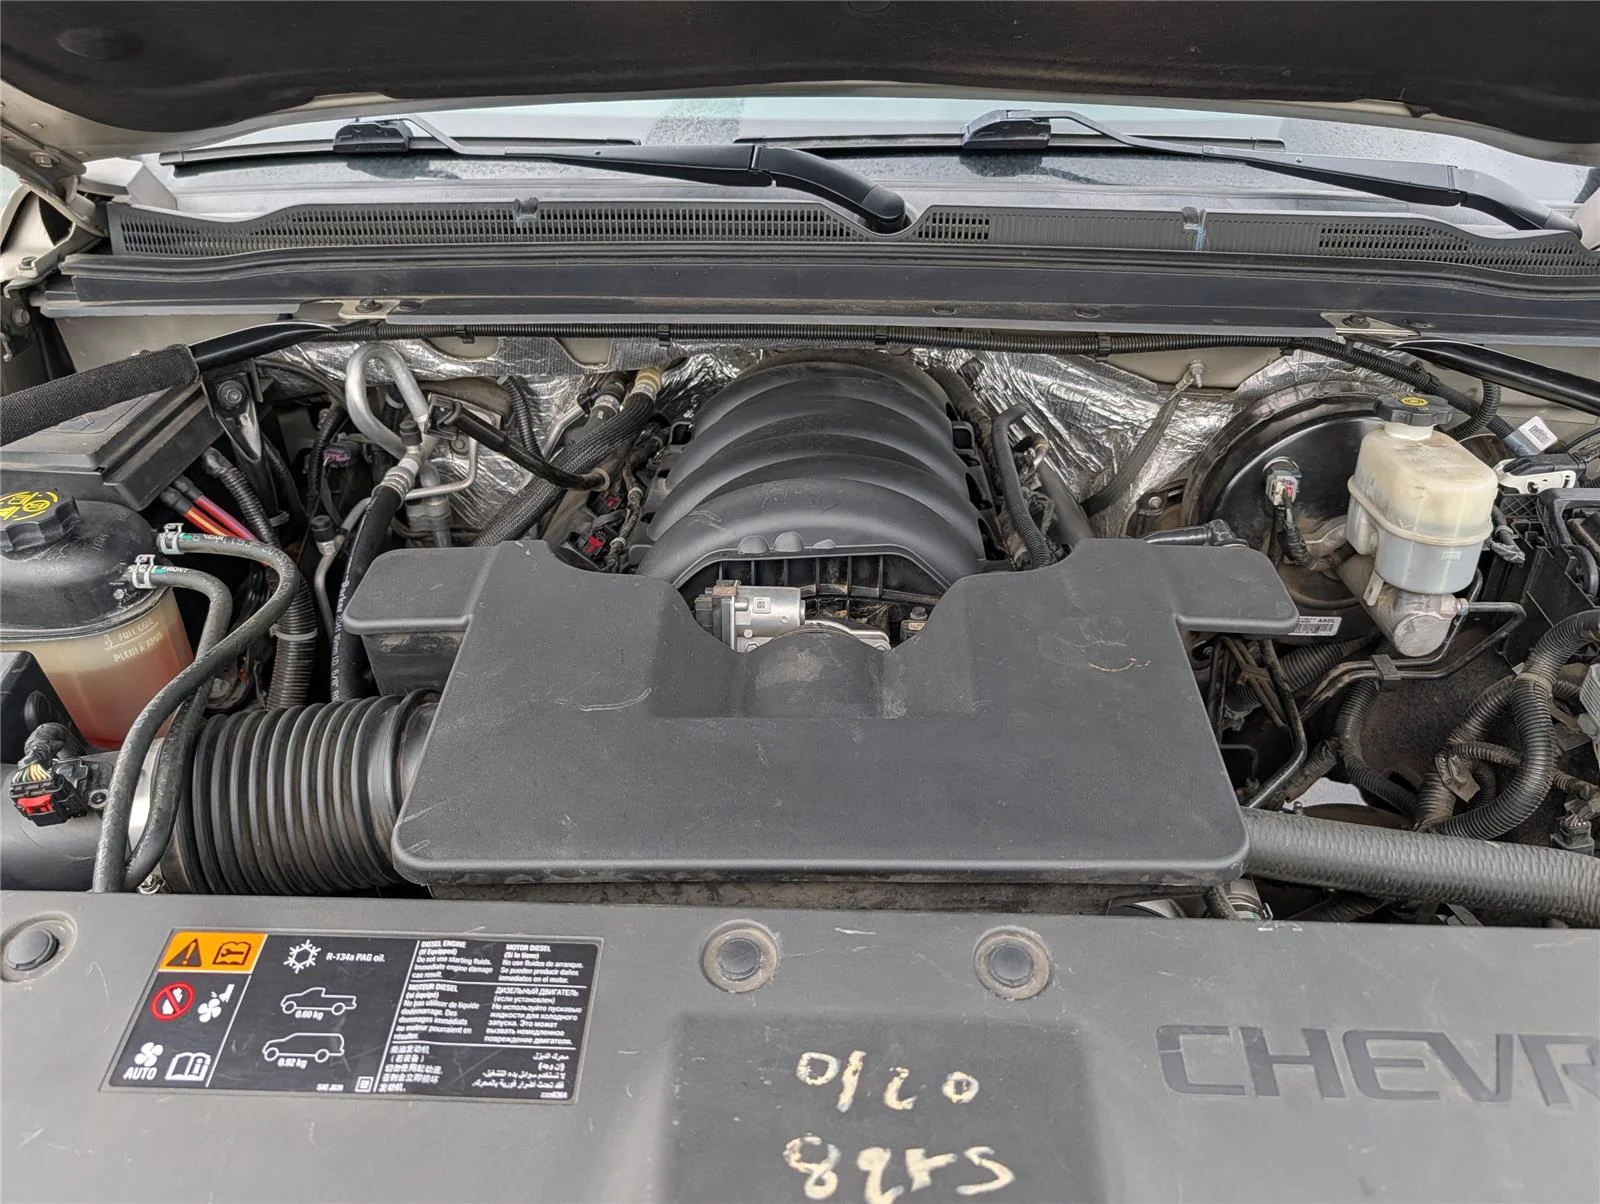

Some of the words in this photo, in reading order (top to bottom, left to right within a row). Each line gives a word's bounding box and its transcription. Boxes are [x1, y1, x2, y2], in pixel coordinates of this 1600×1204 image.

[326, 953, 355, 961] R-134a
[356, 953, 373, 962] PAG
[373, 954, 385, 962] oil.
[448, 956, 472, 965] starting
[468, 965, 493, 974] damage
[312, 1011, 324, 1020] kg
[295, 1058, 307, 1069] kg
[122, 1066, 157, 1080] AUTO
